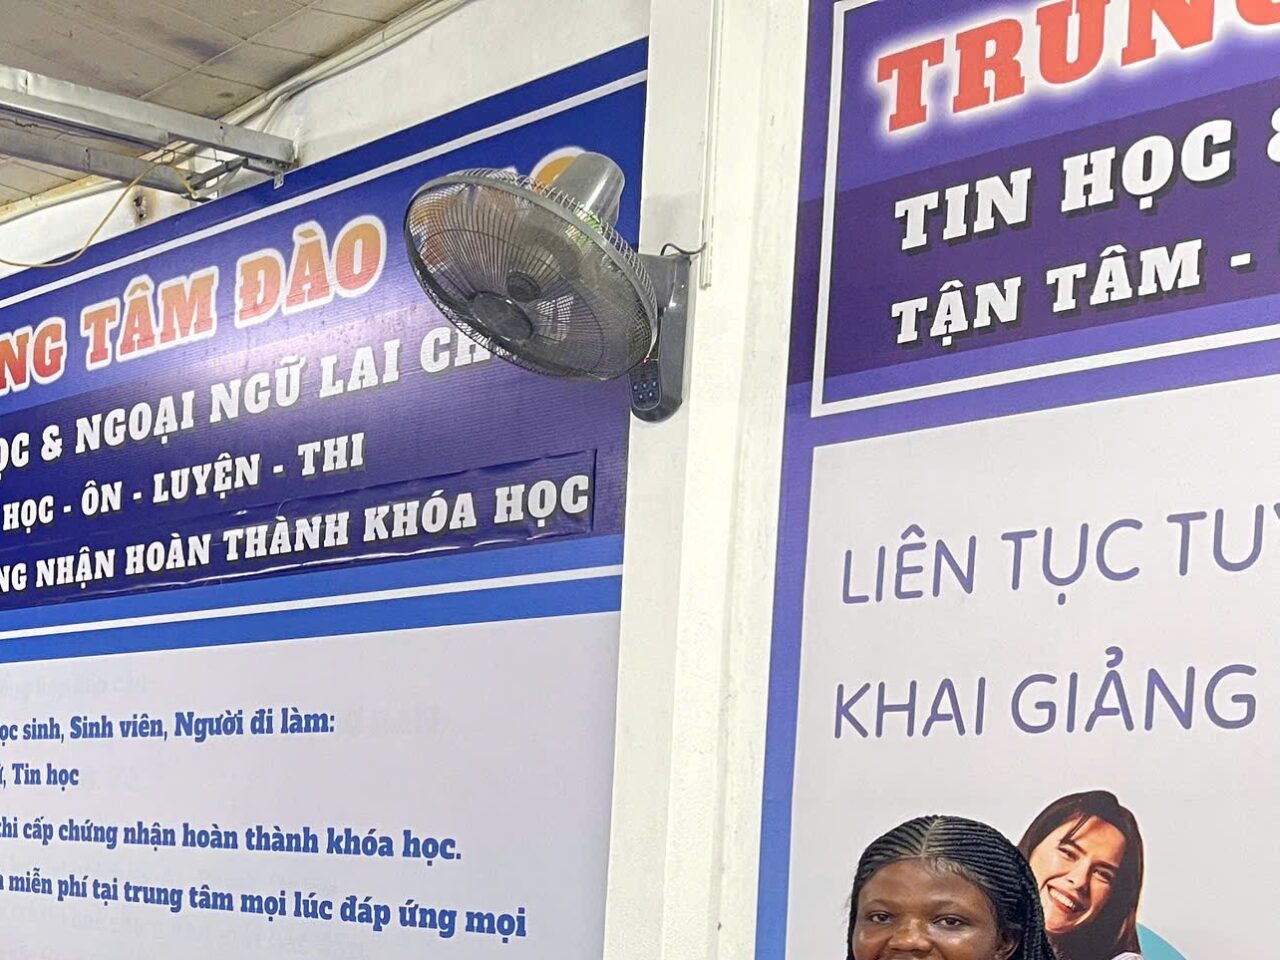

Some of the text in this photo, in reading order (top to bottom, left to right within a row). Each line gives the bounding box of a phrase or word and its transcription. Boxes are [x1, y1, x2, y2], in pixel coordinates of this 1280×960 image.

[877, 0, 1280, 132] TRUN
[894, 167, 1033, 251] TIN
[1061, 119, 1233, 210] HỌC
[82, 275, 218, 367] TÂM
[237, 220, 383, 322] ĐÀO
[891, 278, 1022, 347] TẬN
[1046, 239, 1203, 314] TÂM
[40, 424, 63, 461] &
[75, 389, 195, 454] NGOẠI
[209, 355, 307, 424] NGỮ
[319, 338, 401, 398] LAI
[2, 495, 54, 533] HỌC
[81, 480, 122, 516] ÔN
[153, 452, 260, 504] LUYỆN
[297, 432, 365, 476] THI
[35, 546, 116, 589] NHẬN
[125, 533, 212, 575] HOÀN
[223, 511, 350, 561] THÀNH
[363, 490, 477, 543] KHÓA
[493, 475, 589, 528] HỌC
[842, 503, 1280, 606] LIÊN TỤC TU
[22, 717, 65, 743] sinh,
[70, 715, 114, 739] Sinh
[120, 713, 168, 741] viên,
[174, 709, 244, 743] Người
[250, 708, 274, 735] đi
[280, 707, 335, 734] làm:
[834, 646, 1257, 739] KHAI GIẢNG
[12, 763, 41, 785] Tin
[46, 763, 79, 791] học
[23, 816, 54, 845] cấp
[58, 818, 118, 849] chứng
[122, 821, 176, 851] nhận
[182, 823, 238, 850] hoàn
[245, 825, 319, 854] thành
[326, 827, 394, 857] khóa
[402, 829, 463, 866] học.
[9, 867, 53, 894] miễn
[57, 874, 88, 901] phí
[92, 877, 118, 906] tại
[122, 880, 183, 913] trung
[188, 884, 234, 912] tâm
[240, 889, 287, 922] mọi
[293, 890, 333, 920] lúc
[339, 894, 391, 932] đáp
[398, 898, 457, 939] ứng
[465, 907, 527, 944] mọi
